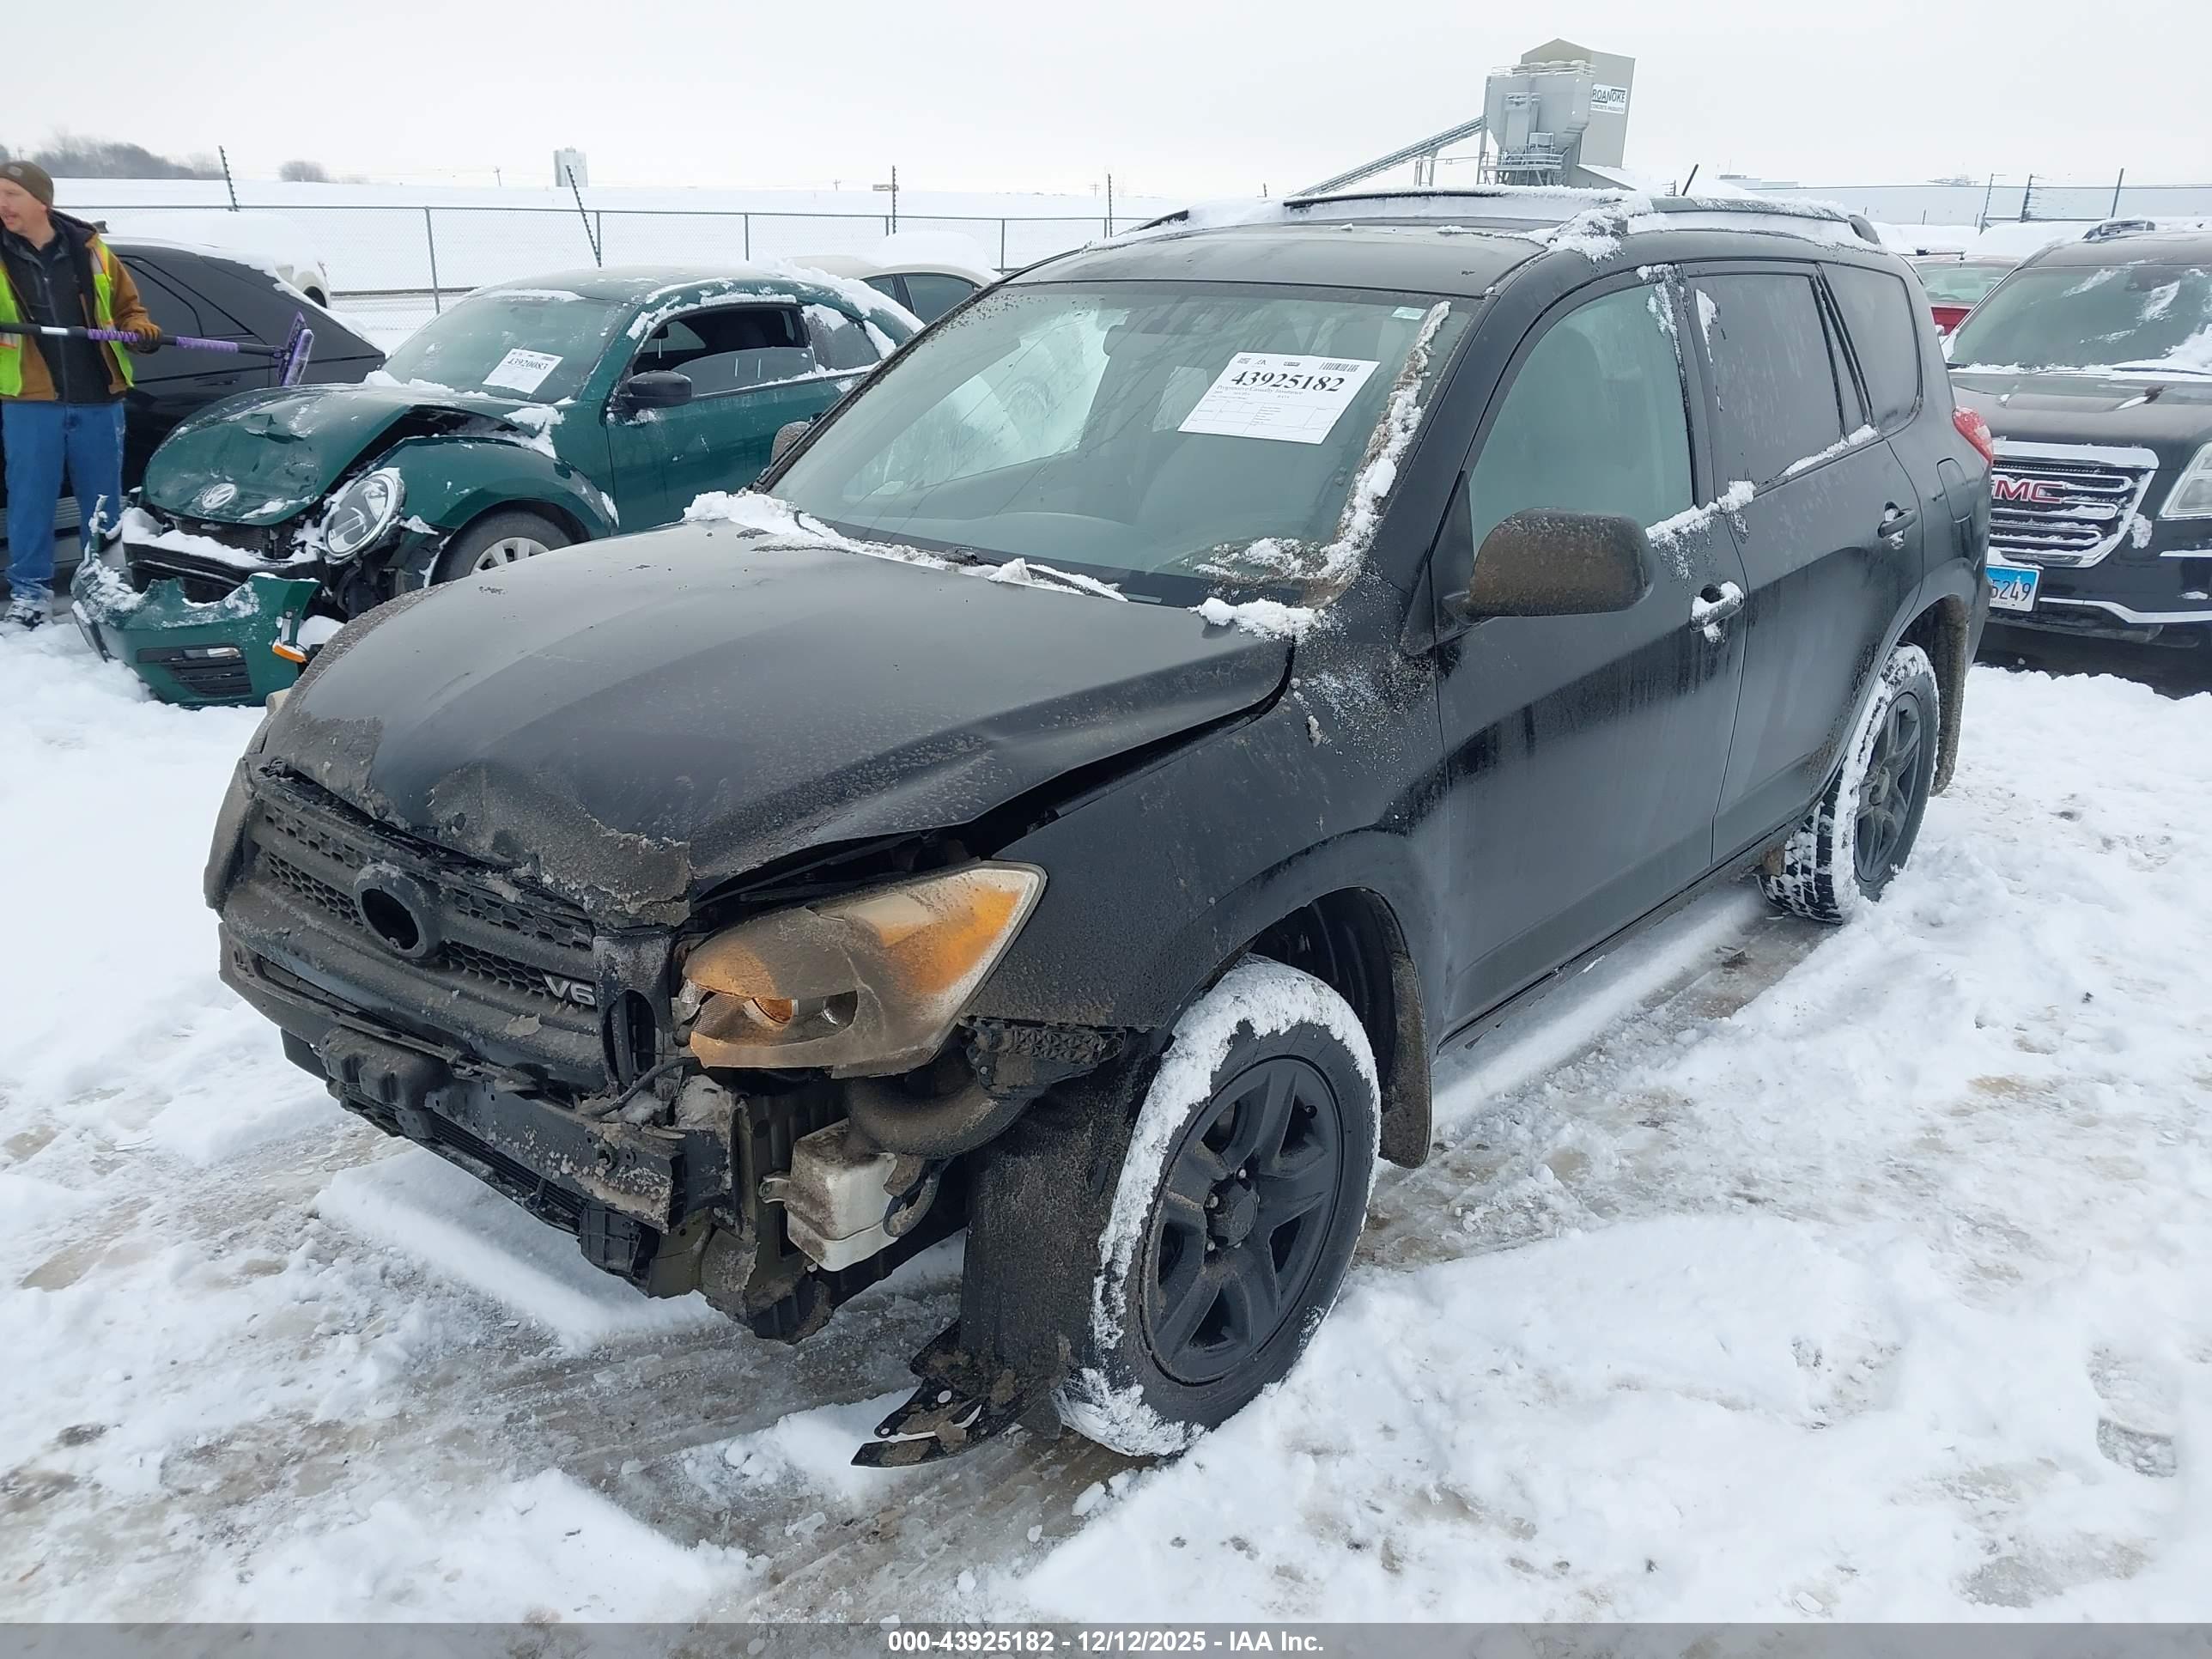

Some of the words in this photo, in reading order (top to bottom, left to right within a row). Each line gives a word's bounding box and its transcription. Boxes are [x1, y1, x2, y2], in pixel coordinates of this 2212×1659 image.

[1592, 88, 1626, 103] ROANOKE
[1231, 370, 1345, 392] 43925182
[1990, 477, 2063, 504] MC
[543, 974, 596, 1006] V6
